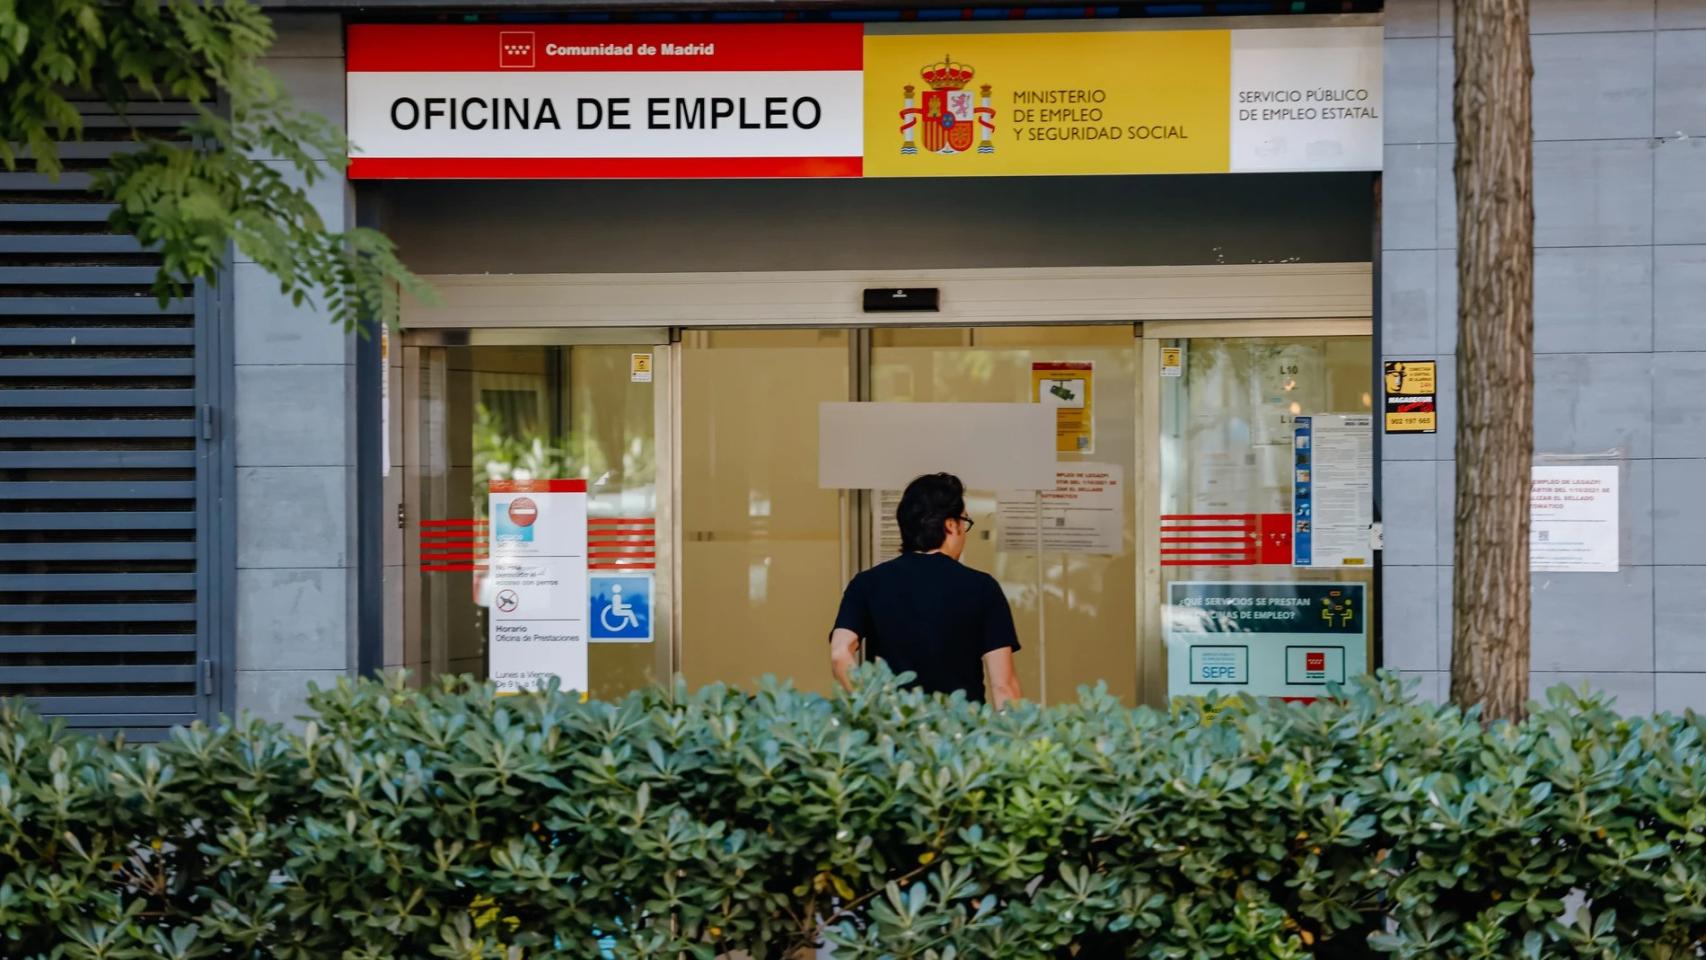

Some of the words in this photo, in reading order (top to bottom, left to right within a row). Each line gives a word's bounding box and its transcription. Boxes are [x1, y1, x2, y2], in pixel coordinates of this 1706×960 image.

[545, 43, 633, 56] Comunidad
[637, 43, 656, 56] de
[661, 43, 714, 56] Madrid
[1013, 89, 1106, 104] MINISTERIO
[1238, 90, 1302, 103] SERVICIO
[1306, 87, 1369, 101] PÚBLICO
[390, 97, 561, 131] OFICINA
[577, 97, 631, 130] DE
[647, 96, 822, 130] EMPLEO
[1013, 109, 1034, 123] DE
[1040, 108, 1103, 122] EMPLEO
[1239, 109, 1258, 121] DE
[1262, 108, 1317, 120] EMPLEO
[1322, 107, 1379, 119] ESTATAL
[1013, 127, 1023, 141] Y
[1028, 126, 1122, 141] SEGURIDAD
[1128, 125, 1188, 140] SOCIAL
[1256, 598, 1267, 606] SE
[1269, 597, 1310, 606] PRESTAN
[1241, 611, 1252, 619] DE
[1254, 611, 1296, 619] EMPLEO?
[496, 634, 521, 642] Oficina
[523, 634, 532, 642] de
[534, 634, 579, 642] Prestaciones
[1202, 666, 1236, 678] SEPE
